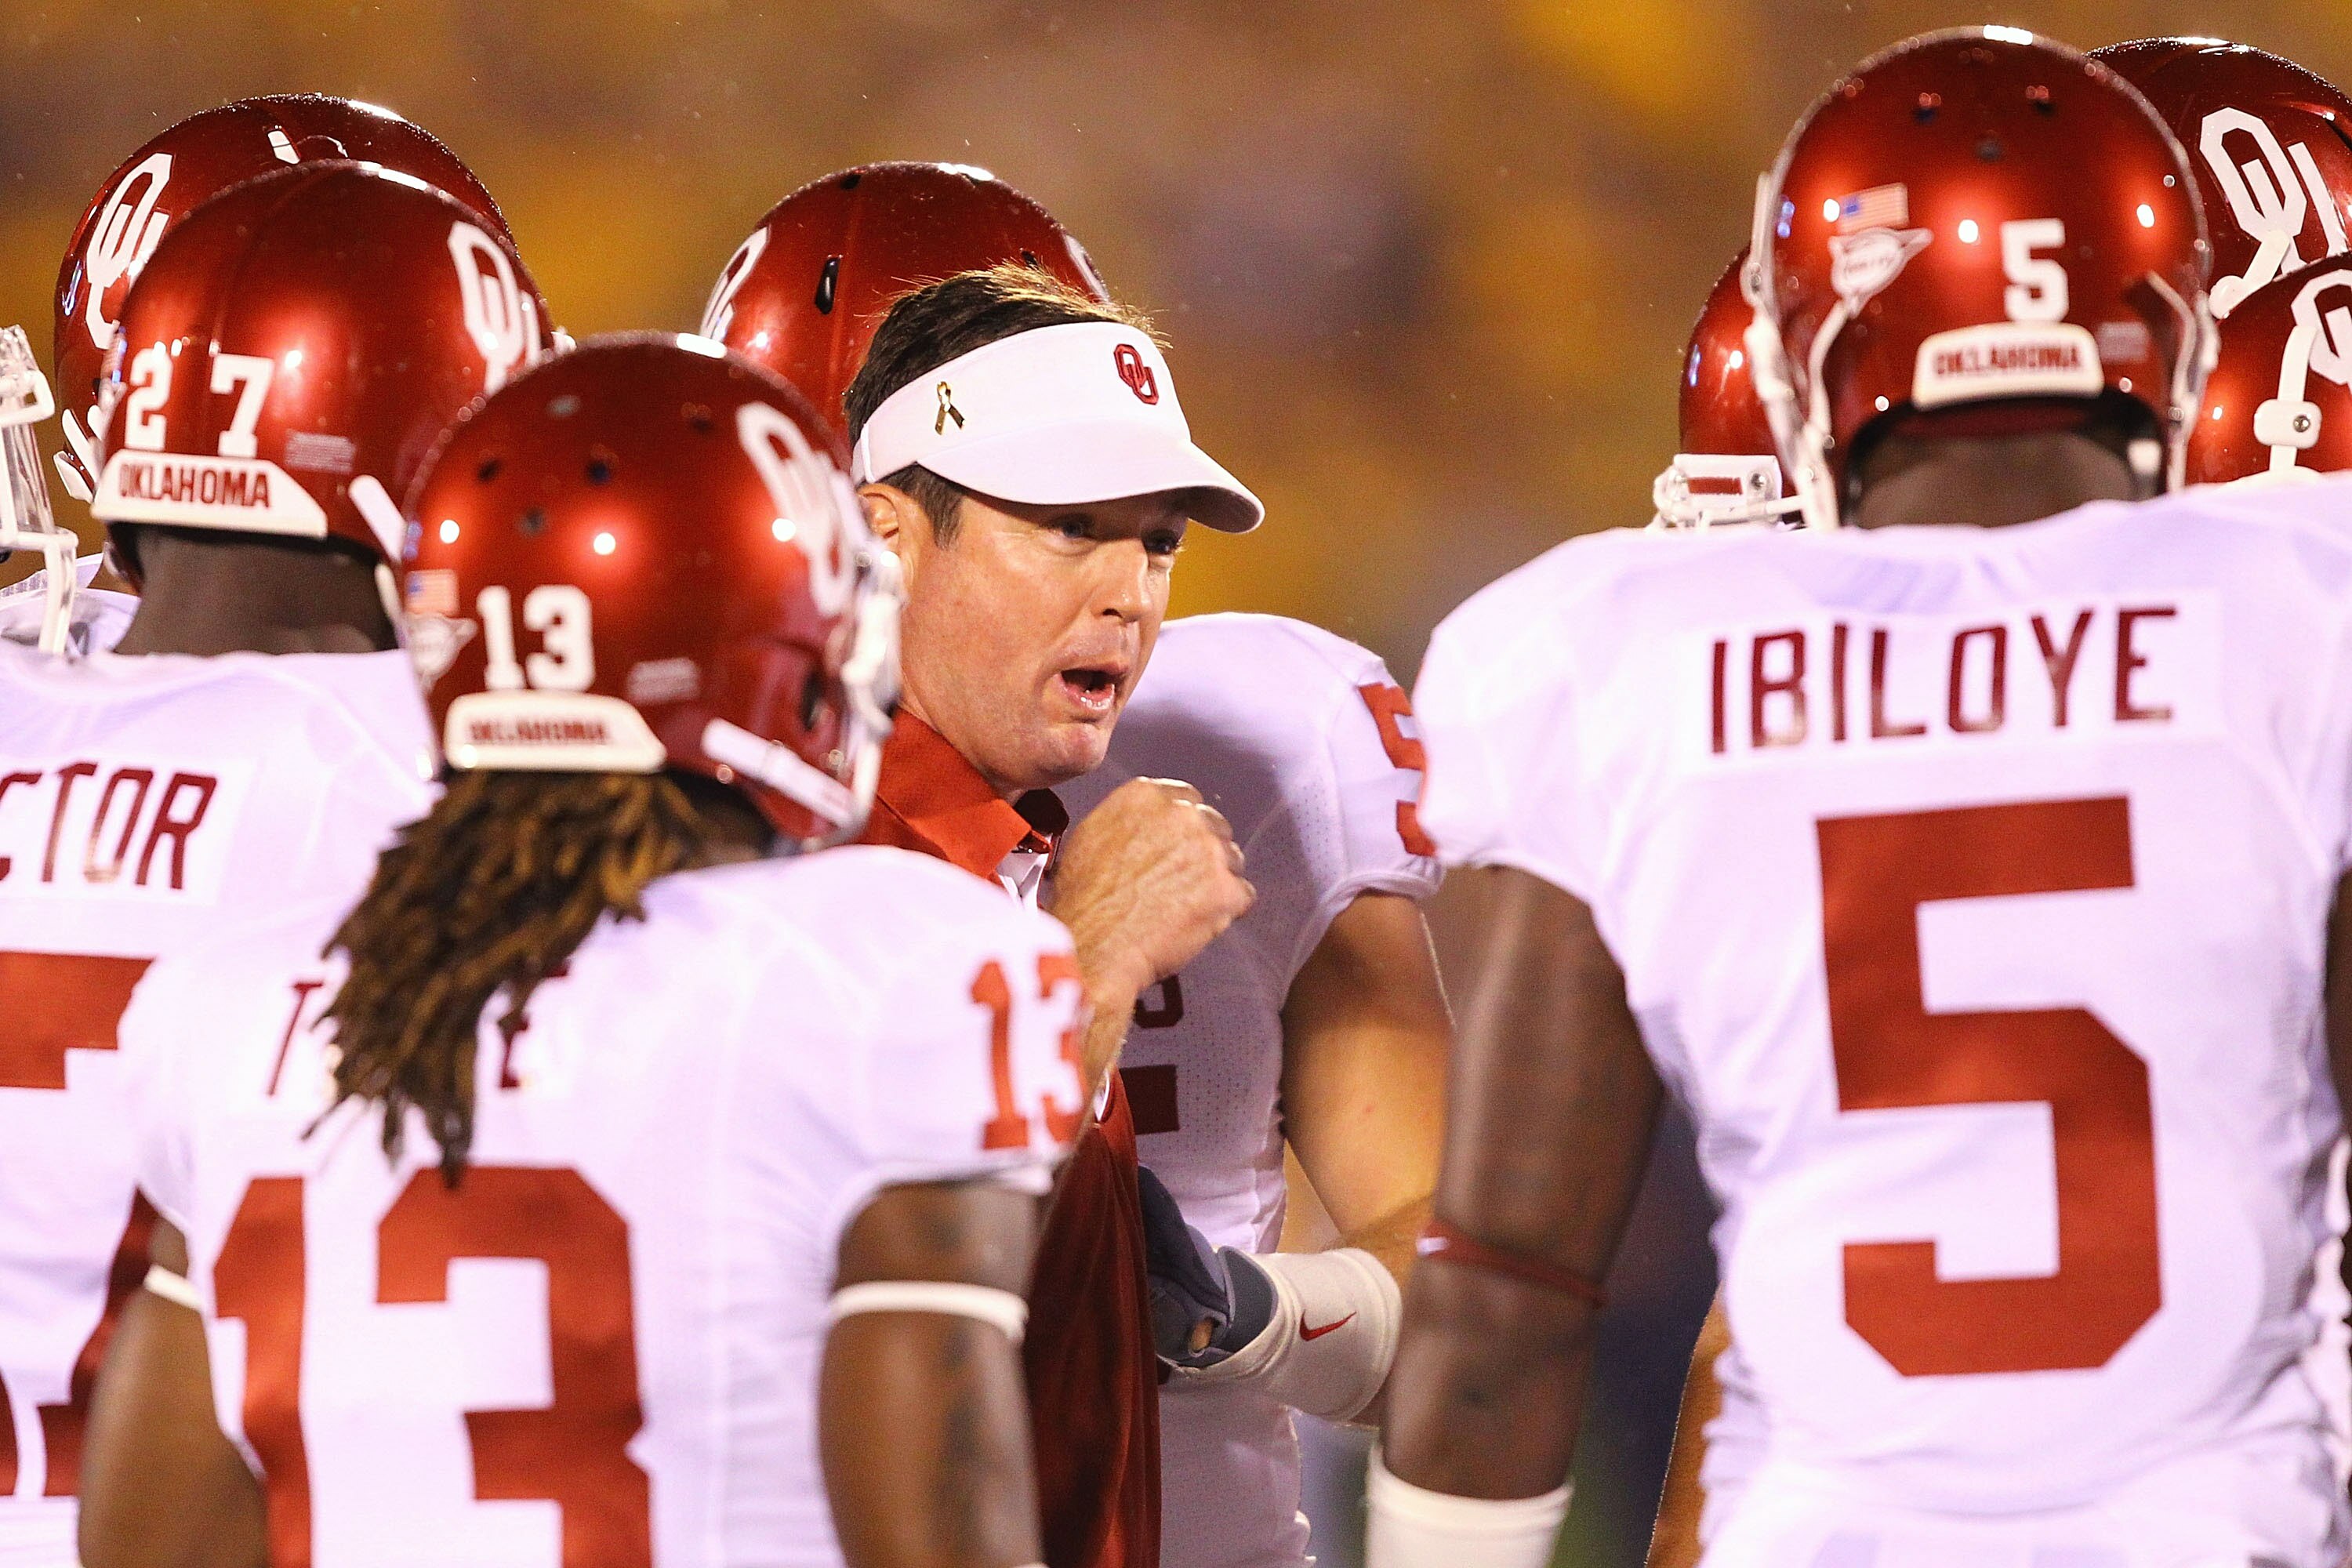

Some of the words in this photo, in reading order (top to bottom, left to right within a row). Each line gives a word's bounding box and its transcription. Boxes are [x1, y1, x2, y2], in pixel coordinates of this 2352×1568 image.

[2000, 218, 2070, 325] 5
[124, 348, 274, 459] 27
[1113, 343, 1160, 405] OU
[1935, 345, 2082, 376] OKLAHOMA
[119, 463, 271, 508] OKLAHOMA
[477, 585, 594, 691] 13
[1710, 605, 2178, 754] IBILOYE
[470, 718, 608, 743] OKLAHOMA
[971, 951, 1088, 1149] 13
[1816, 794, 2164, 1377] 5
[213, 1165, 655, 1568] 13
